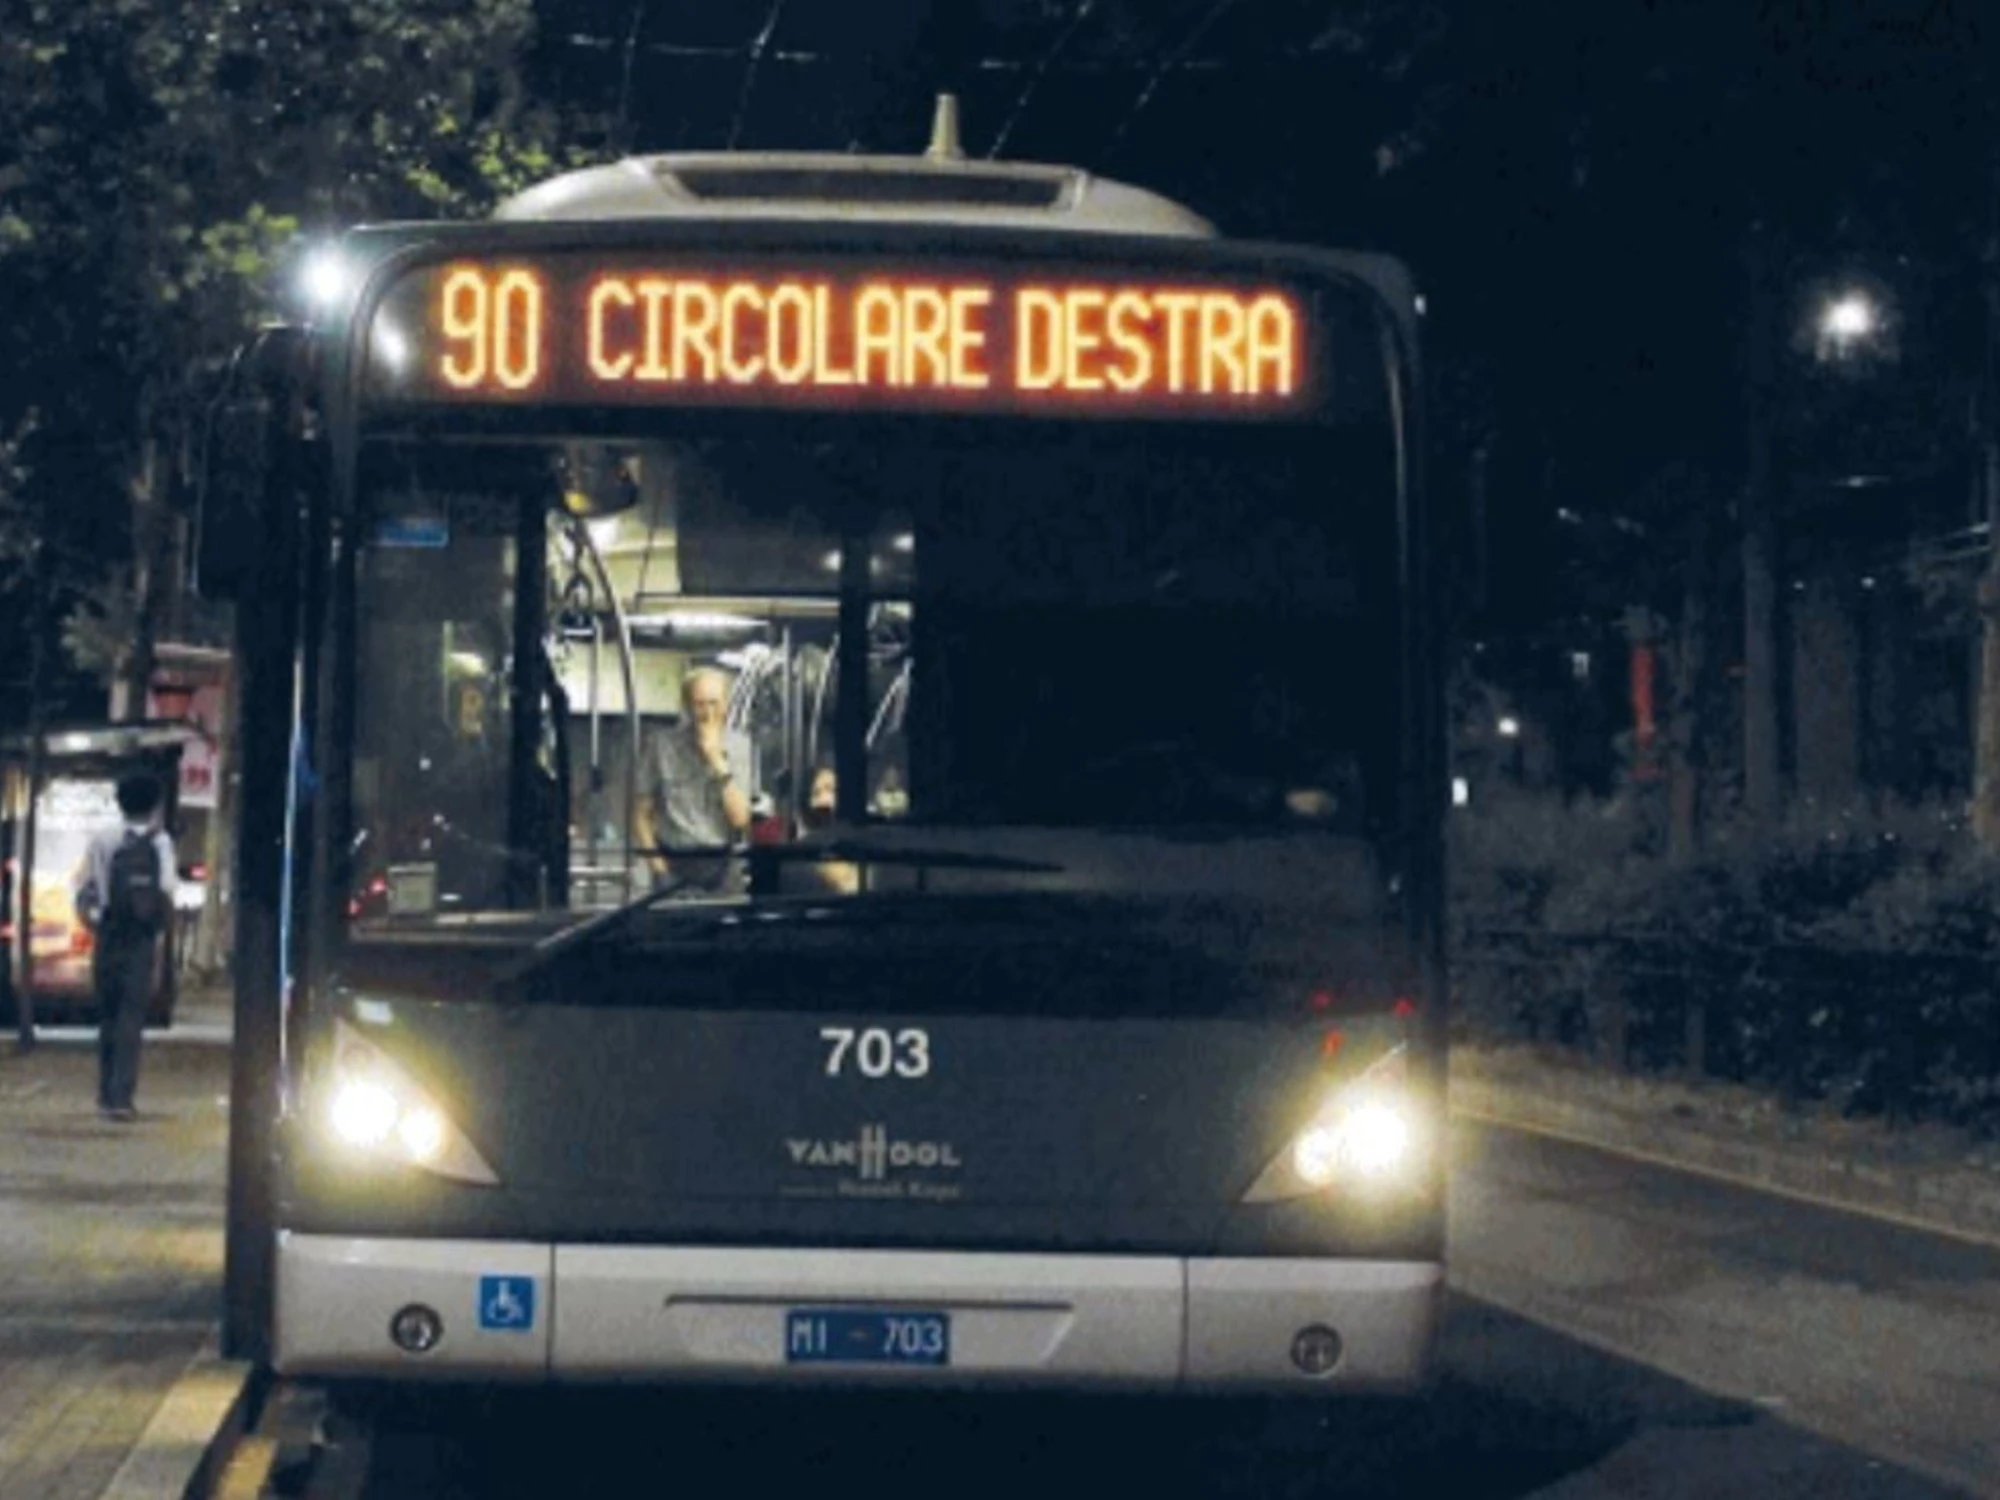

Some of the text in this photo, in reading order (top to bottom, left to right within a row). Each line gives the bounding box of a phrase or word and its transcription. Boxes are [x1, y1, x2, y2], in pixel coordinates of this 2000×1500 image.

[441, 269, 1293, 394] 90 CIRCOLARE DESTRA
[820, 1027, 930, 1079] 703
[791, 1316, 944, 1356] MI 703
